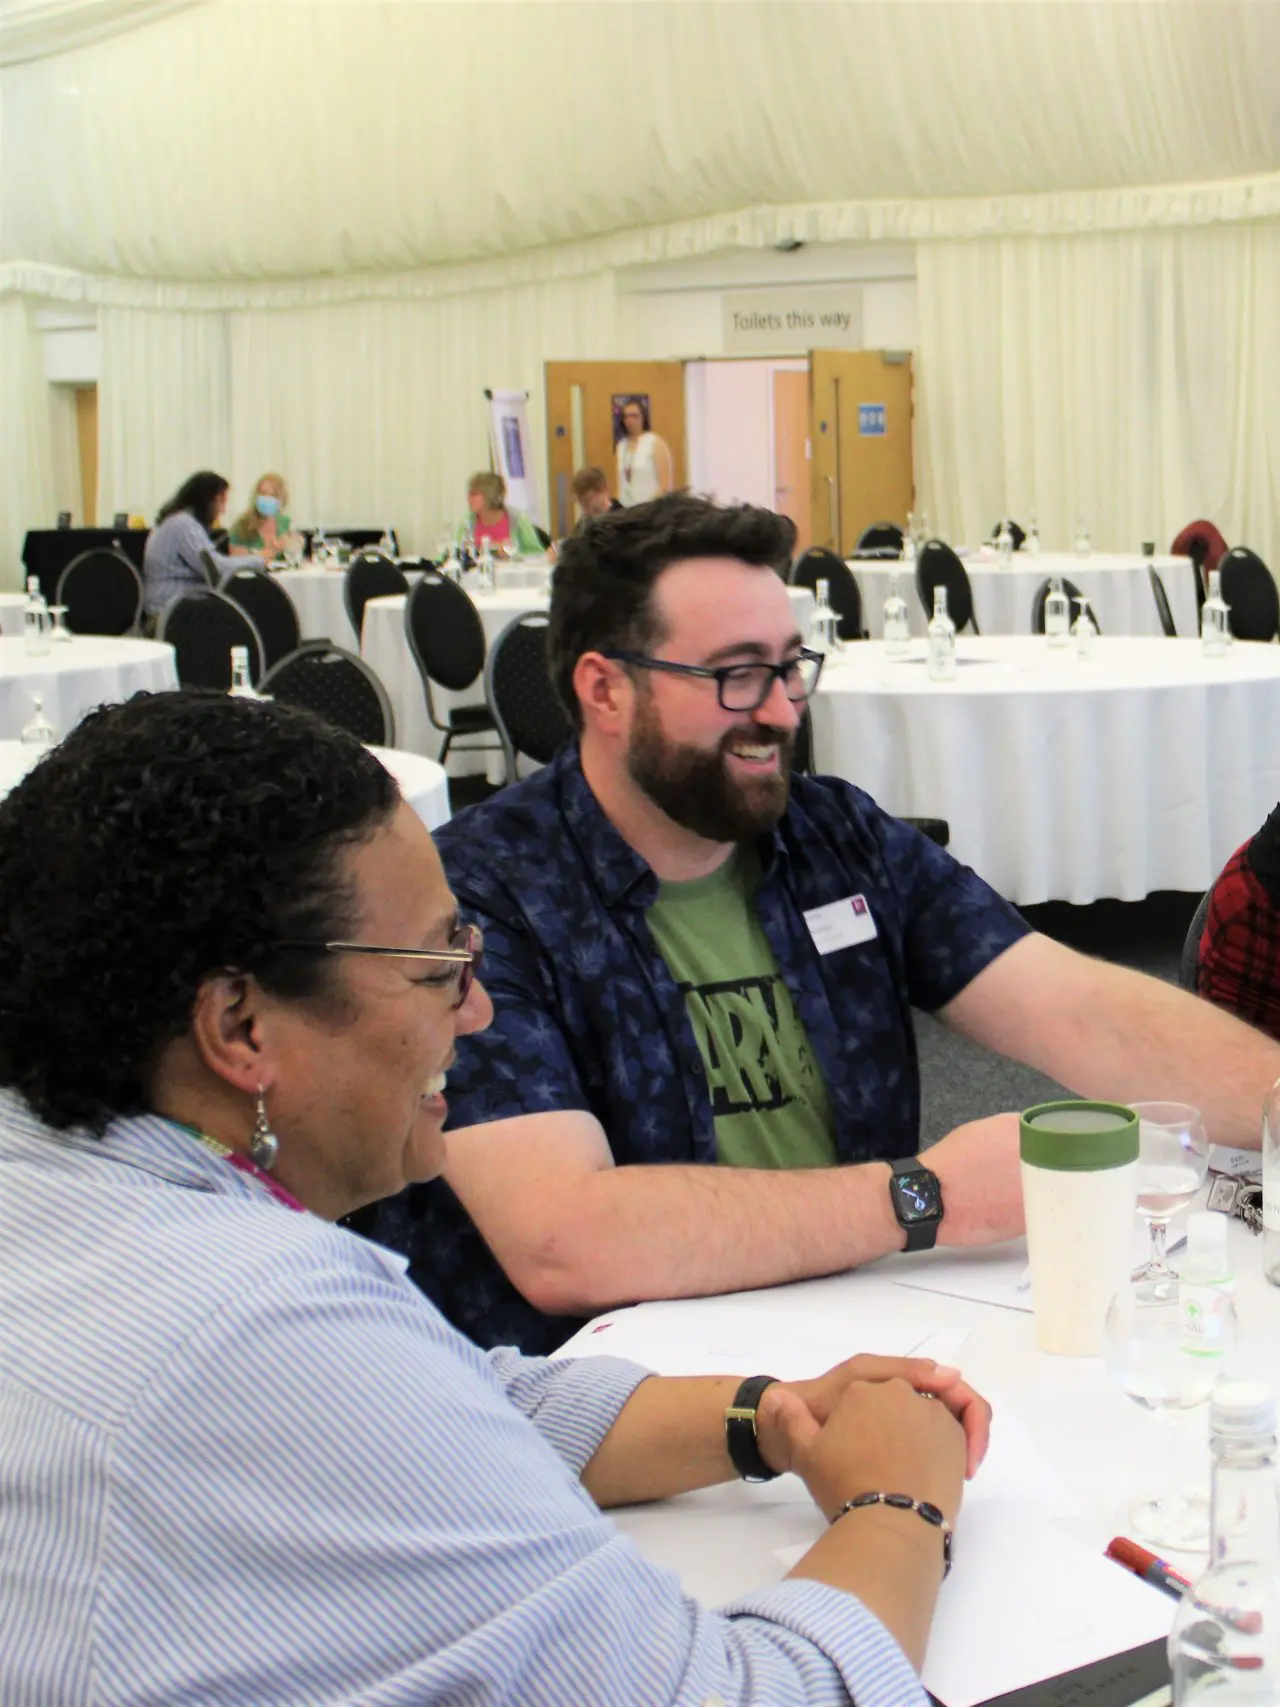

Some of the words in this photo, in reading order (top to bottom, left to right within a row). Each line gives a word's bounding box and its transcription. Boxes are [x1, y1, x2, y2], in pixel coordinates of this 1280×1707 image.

[733, 311, 782, 332] Toilets
[786, 310, 815, 329] this
[819, 313, 852, 333] way
